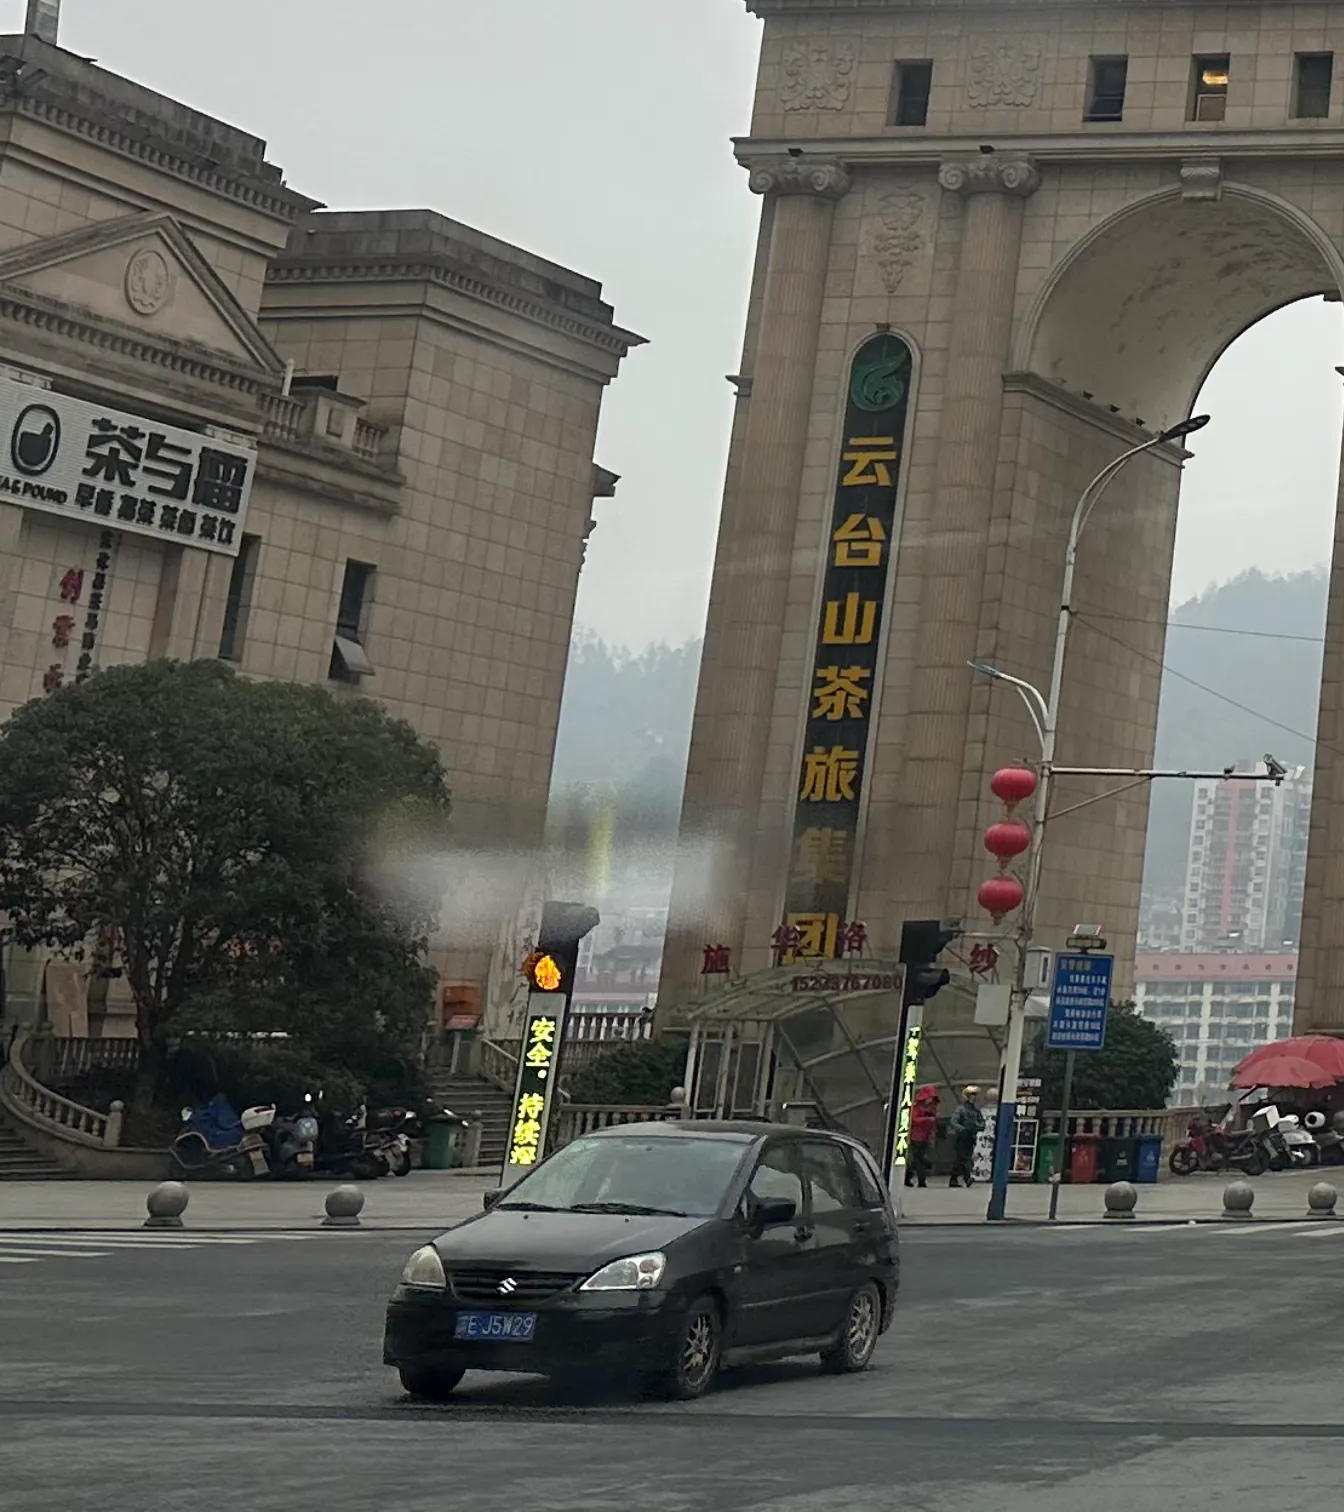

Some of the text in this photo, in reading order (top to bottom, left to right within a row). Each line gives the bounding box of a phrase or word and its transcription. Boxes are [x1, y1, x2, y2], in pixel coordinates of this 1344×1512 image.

[786, 435, 897, 962] 云台山茶旅集团
